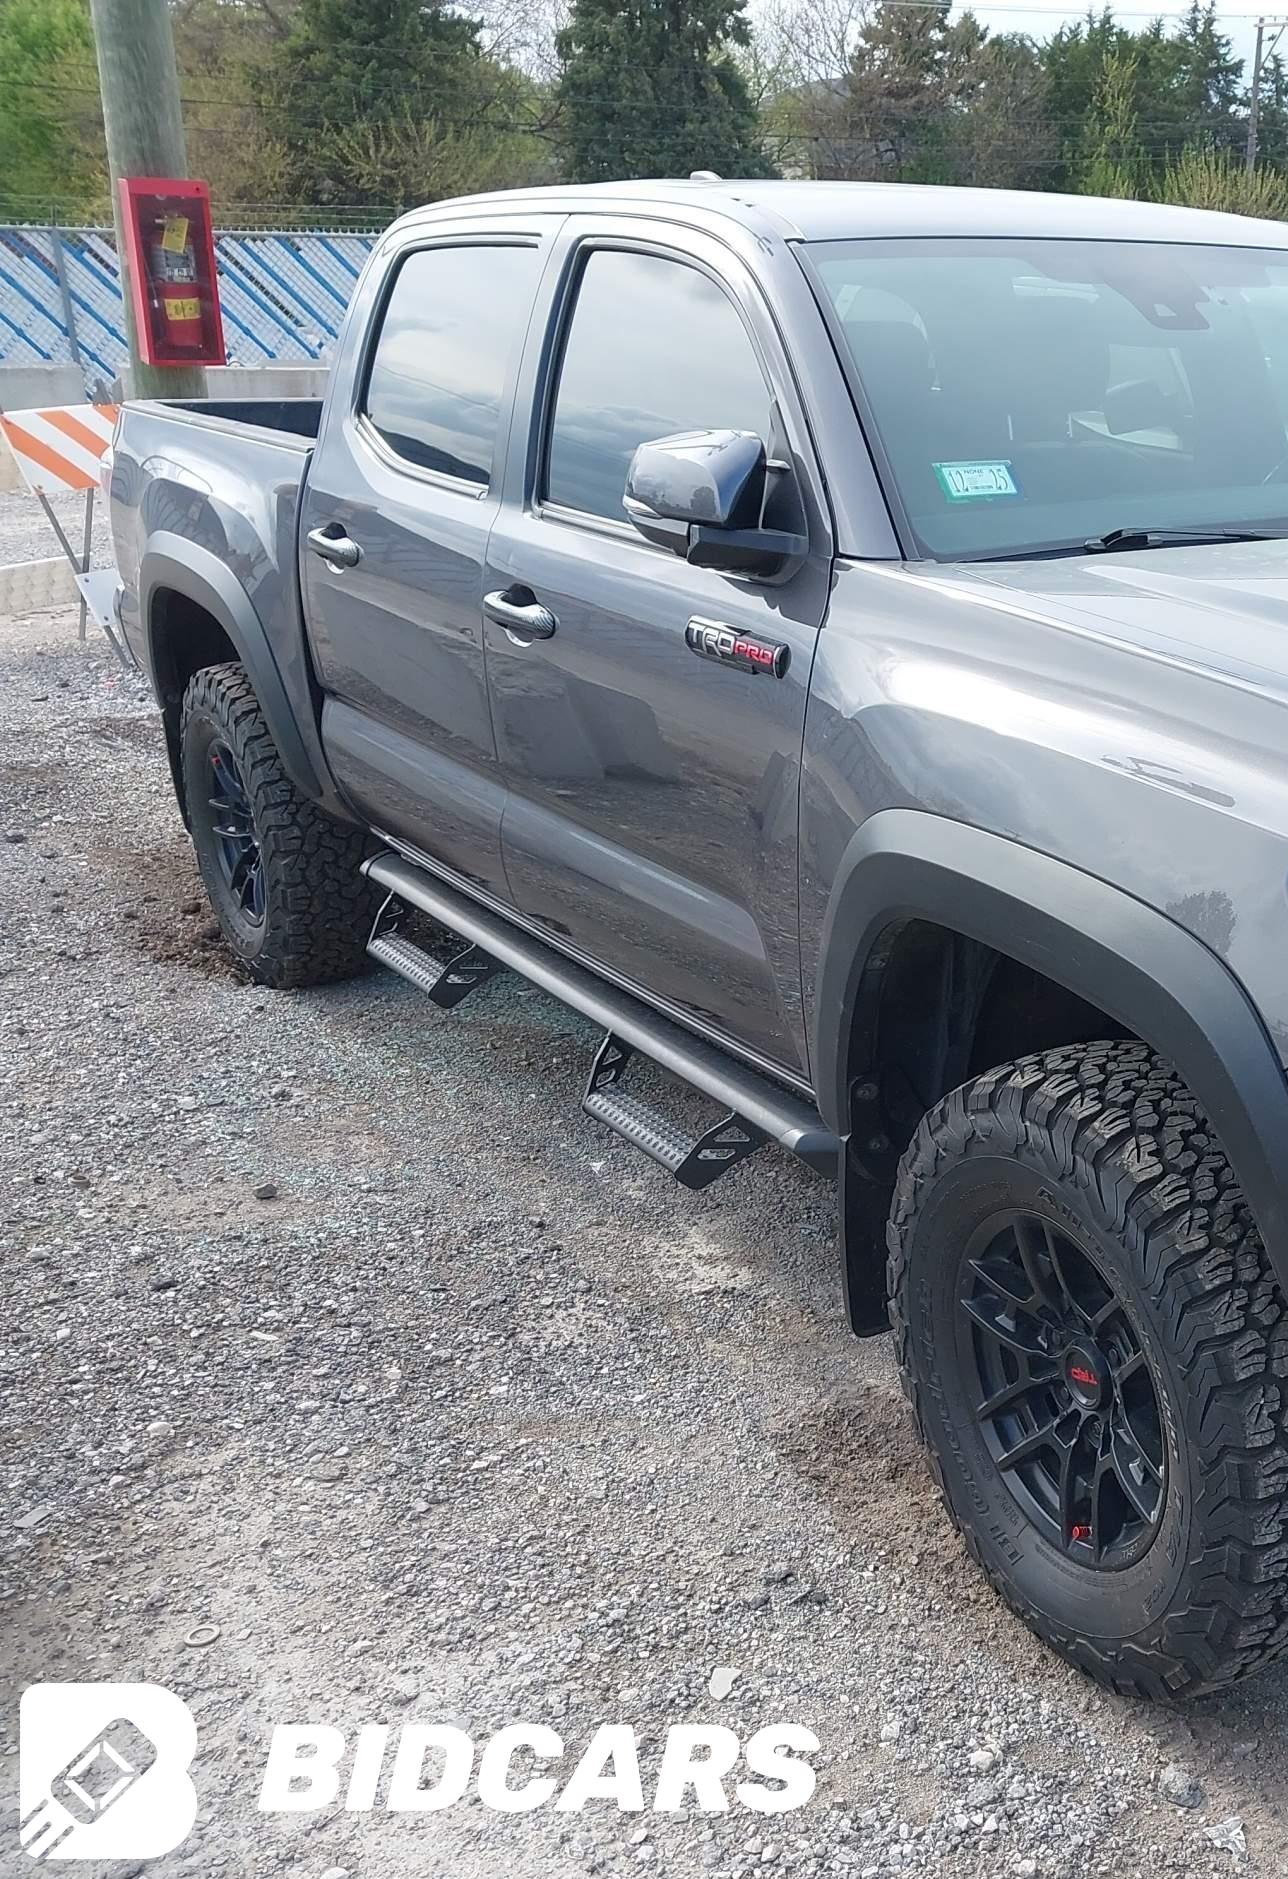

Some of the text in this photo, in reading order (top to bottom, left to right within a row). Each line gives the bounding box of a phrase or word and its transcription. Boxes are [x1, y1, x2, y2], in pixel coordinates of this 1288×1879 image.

[989, 469, 1009, 491] 25
[688, 621, 773, 665] TRD PRO
